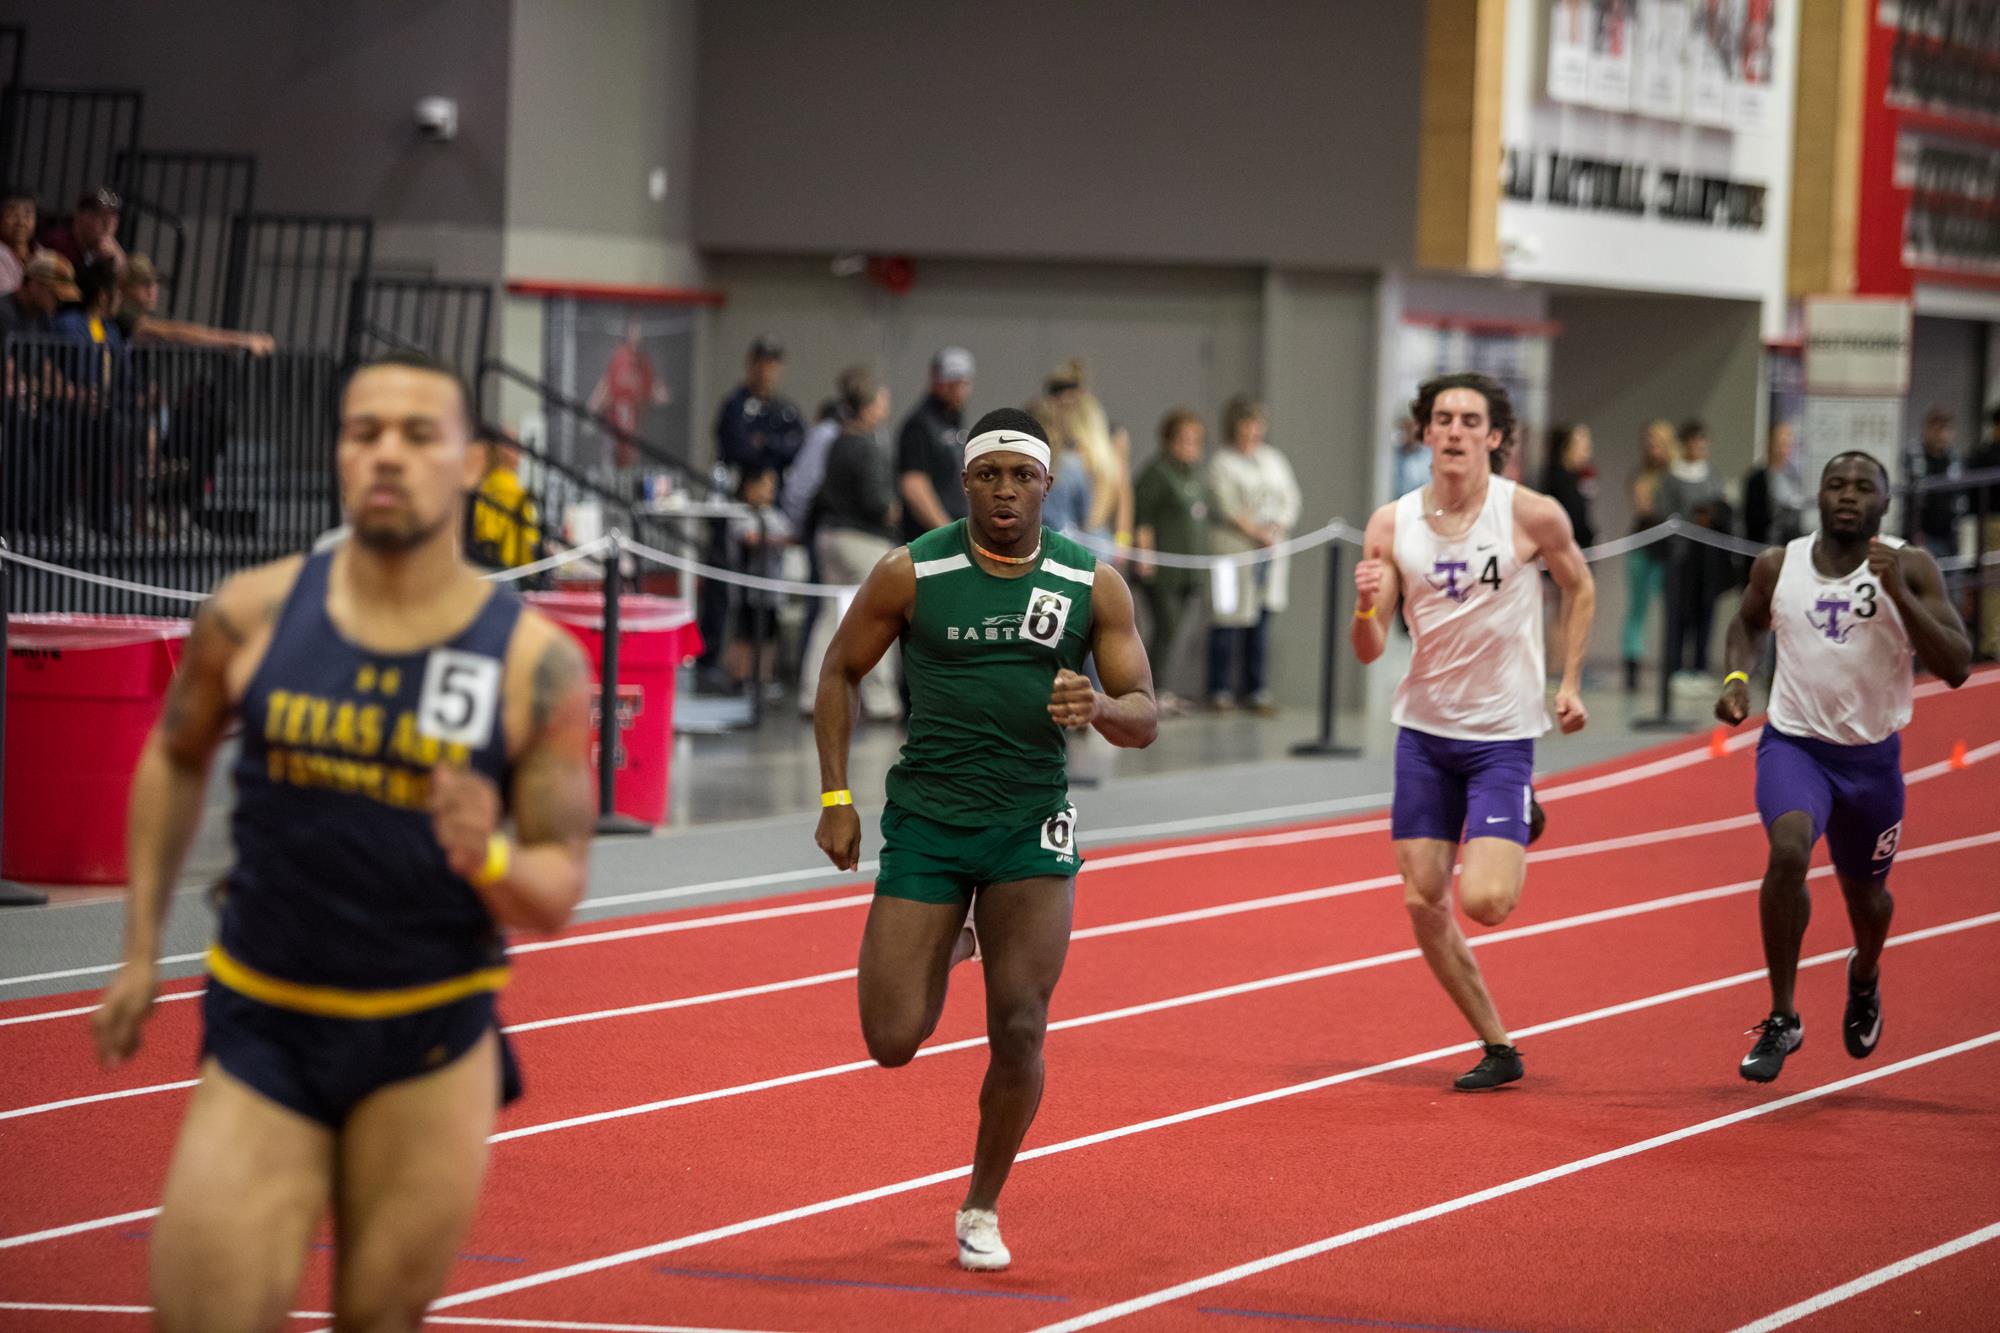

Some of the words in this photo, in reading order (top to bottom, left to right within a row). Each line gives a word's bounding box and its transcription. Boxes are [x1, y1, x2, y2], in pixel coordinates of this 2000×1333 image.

[1479, 554, 1503, 592] 4
[1027, 594, 1063, 641] 6
[1815, 600, 1851, 638] T
[1854, 583, 1878, 618] 3
[432, 663, 477, 732] 5
[1878, 826, 1898, 857] 3
